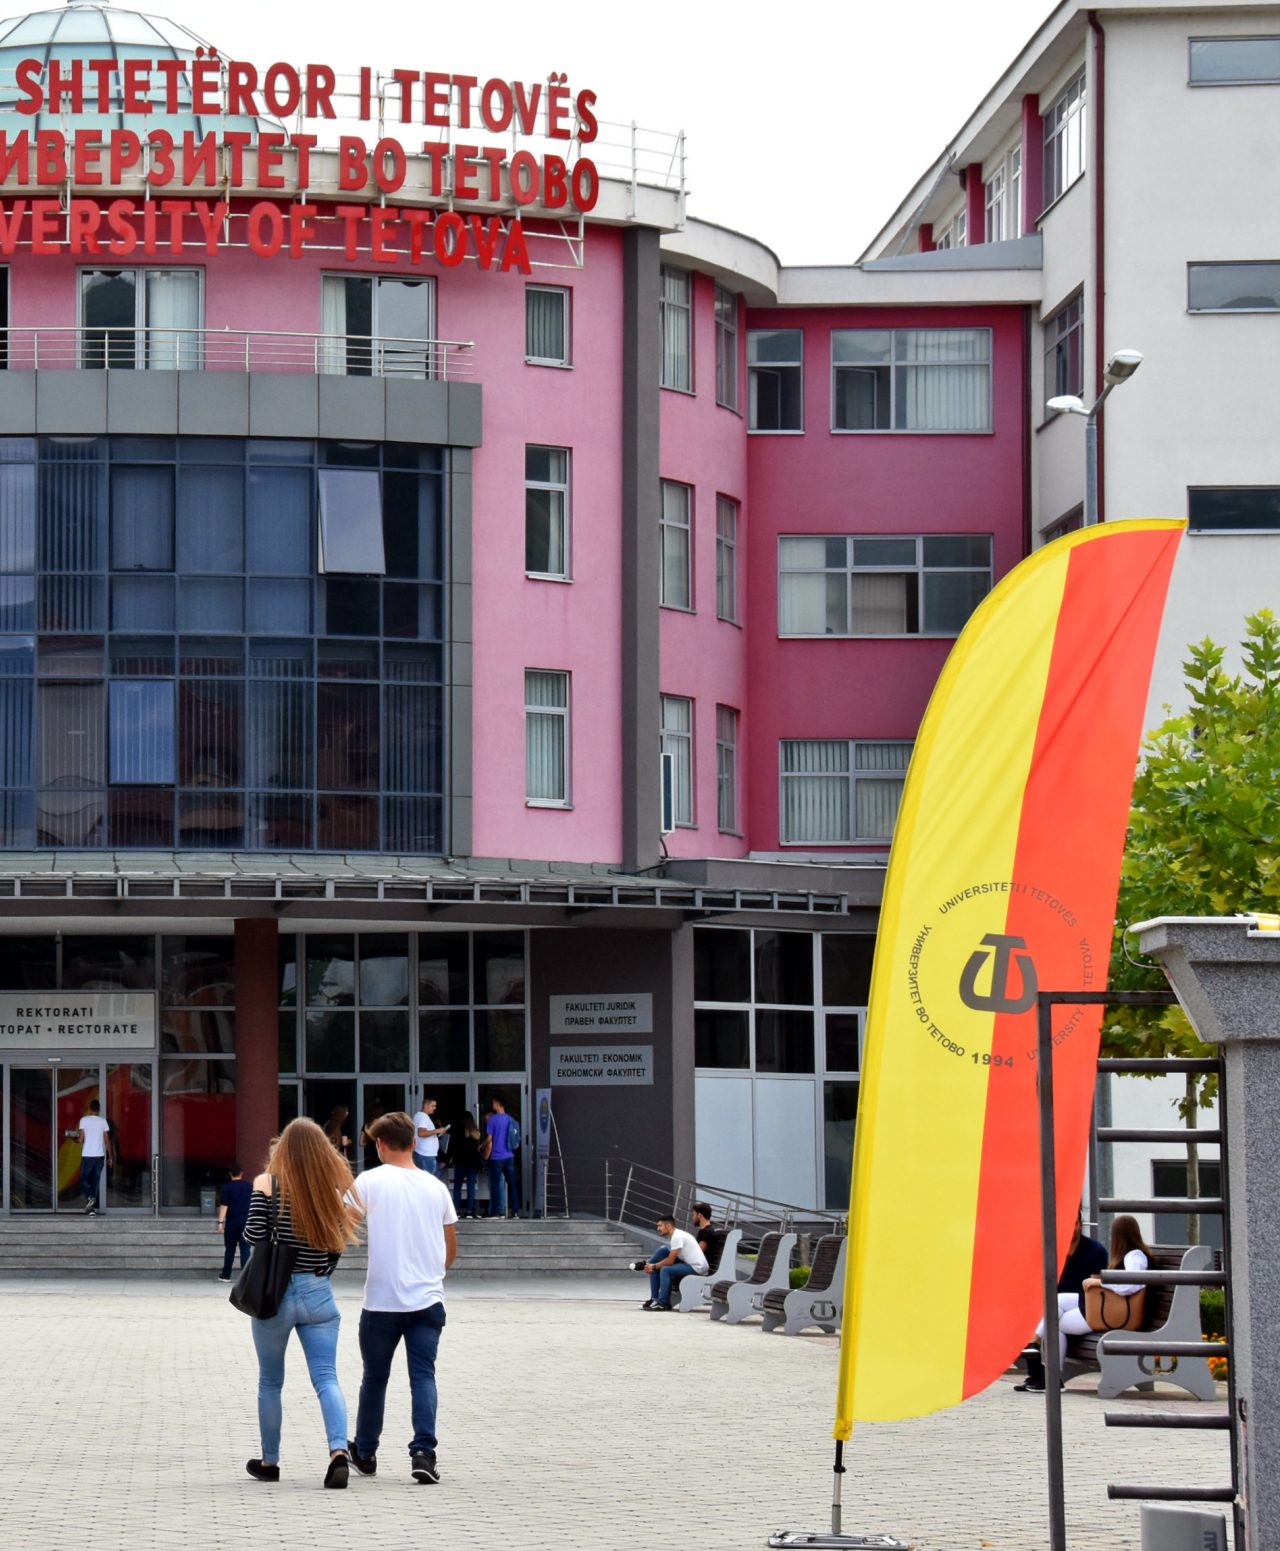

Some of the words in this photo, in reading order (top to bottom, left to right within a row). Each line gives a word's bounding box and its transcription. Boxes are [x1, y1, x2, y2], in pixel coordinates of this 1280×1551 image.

[14, 46, 337, 119] SHTETËROR
[359, 66, 372, 121] I
[393, 71, 599, 144] TETOVËS
[339, 135, 407, 194] ВО
[424, 141, 600, 214] ТЕТОВО
[248, 201, 318, 260] OF
[335, 205, 532, 275] TETOVA
[938, 882, 1020, 915] UNIVERSITETI
[908, 924, 932, 1005] УНИВЕРЗИТЕТ
[1080, 937, 1093, 986] TETOVA
[16, 1007, 94, 1017] REKTORATI
[564, 1016, 595, 1026] ПРАВЕН
[565, 1002, 605, 1012] FAKULTETI
[606, 1001, 636, 1011] JURIDIK
[57, 1023, 138, 1035] RECTORATE
[1026, 1007, 1084, 1061] UERSITY
[559, 1054, 600, 1064] FAKULTETI
[602, 1053, 643, 1063] EKONOMIK
[970, 1052, 1015, 1068] 1994
